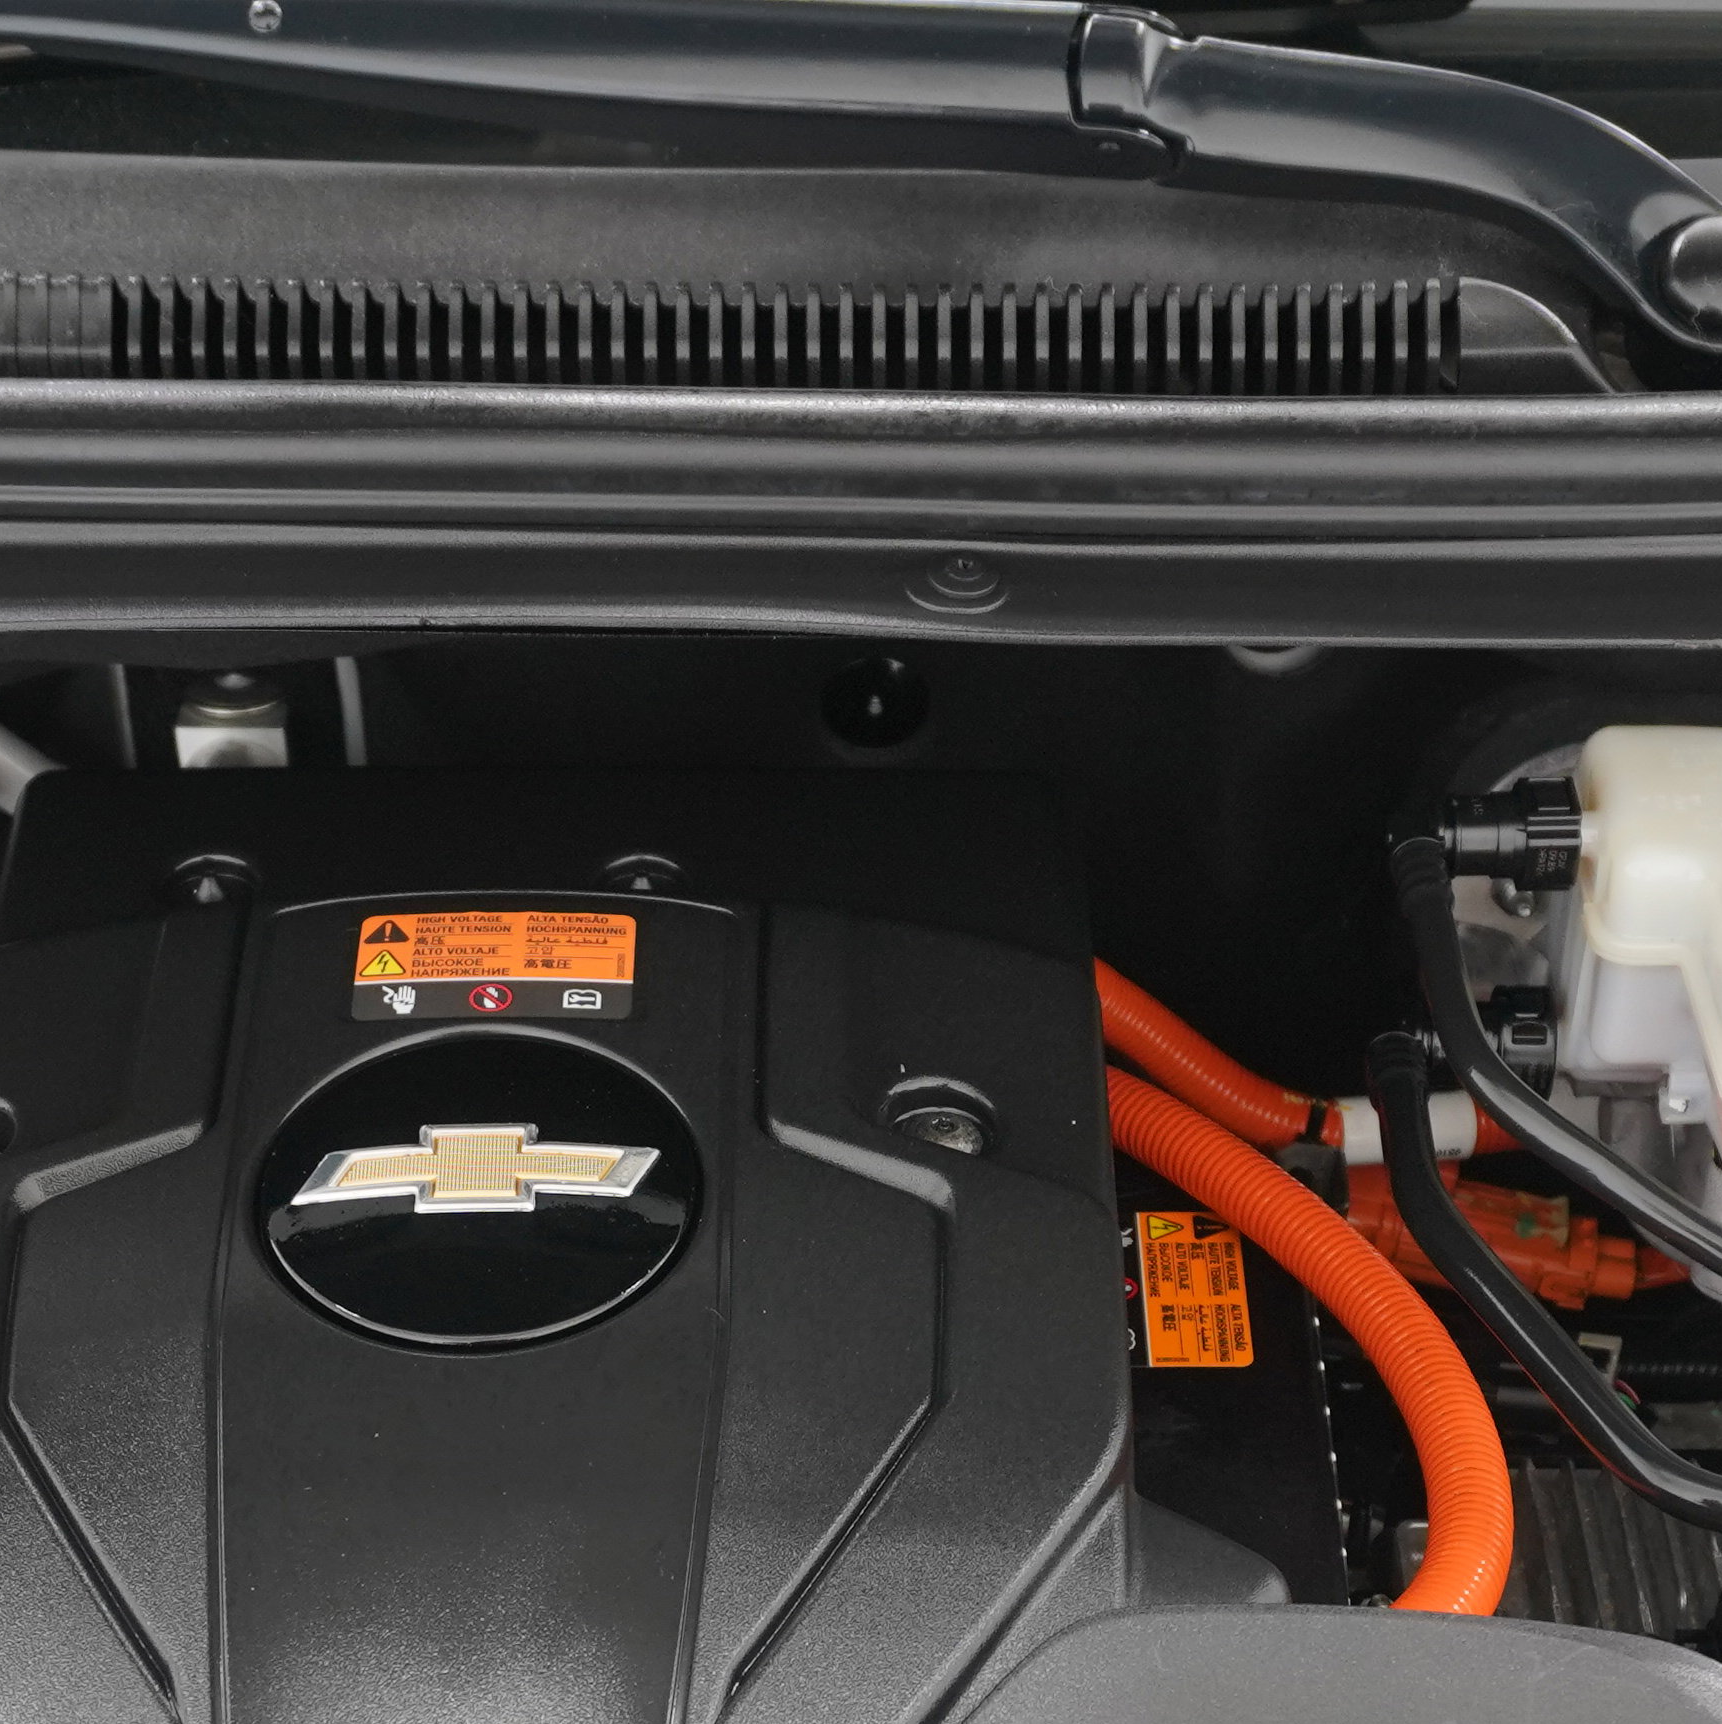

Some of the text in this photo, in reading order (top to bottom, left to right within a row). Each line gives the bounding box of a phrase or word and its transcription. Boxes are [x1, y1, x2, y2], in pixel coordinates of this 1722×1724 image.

[450, 915, 502, 923] VOLTAGE
[527, 914, 608, 925] ALTA TENSÃO
[415, 925, 512, 934] HAUTE TENSION
[527, 926, 627, 936] HOCHSPANNUNG
[413, 946, 499, 956] ALTO VOLTAJE
[412, 957, 483, 968] ВЫСОКОЕ
[410, 968, 510, 978] НАПРЯЖЕНИЕ
